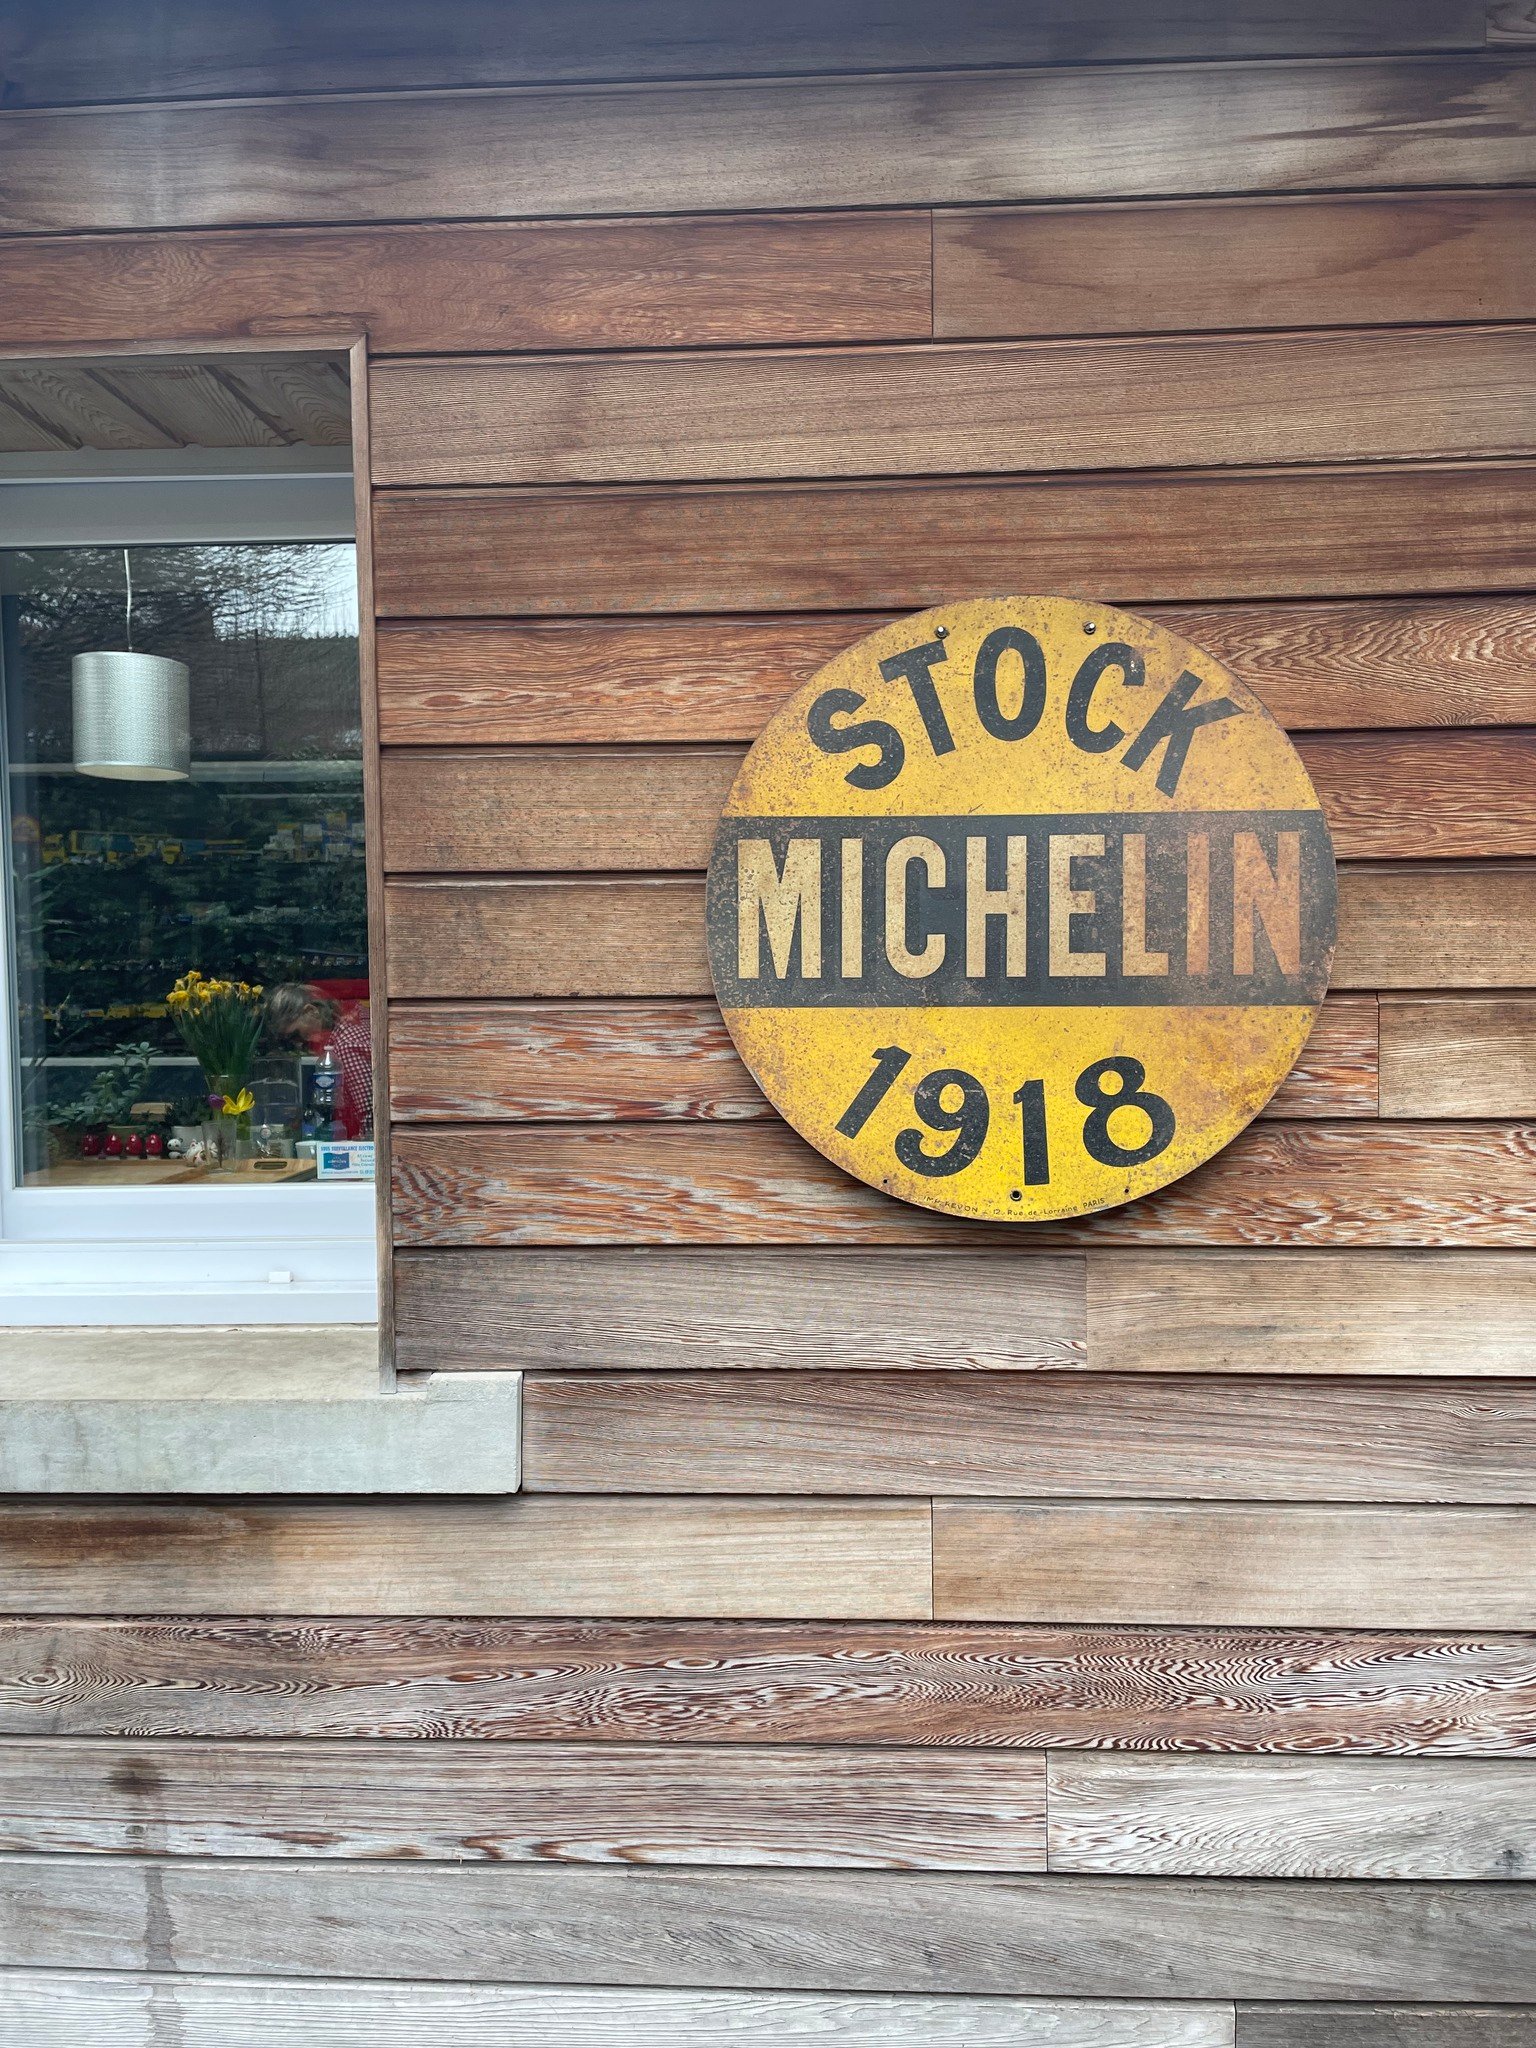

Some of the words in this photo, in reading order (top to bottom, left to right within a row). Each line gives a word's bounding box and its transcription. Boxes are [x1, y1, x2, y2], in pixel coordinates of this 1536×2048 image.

[807, 626, 1243, 799] STOCK
[737, 831, 1301, 980] MICHELIN
[834, 1045, 1177, 1186] 1918
[1043, 1204, 1078, 1215] Lorraine
[1082, 1198, 1105, 1209] PARIS
